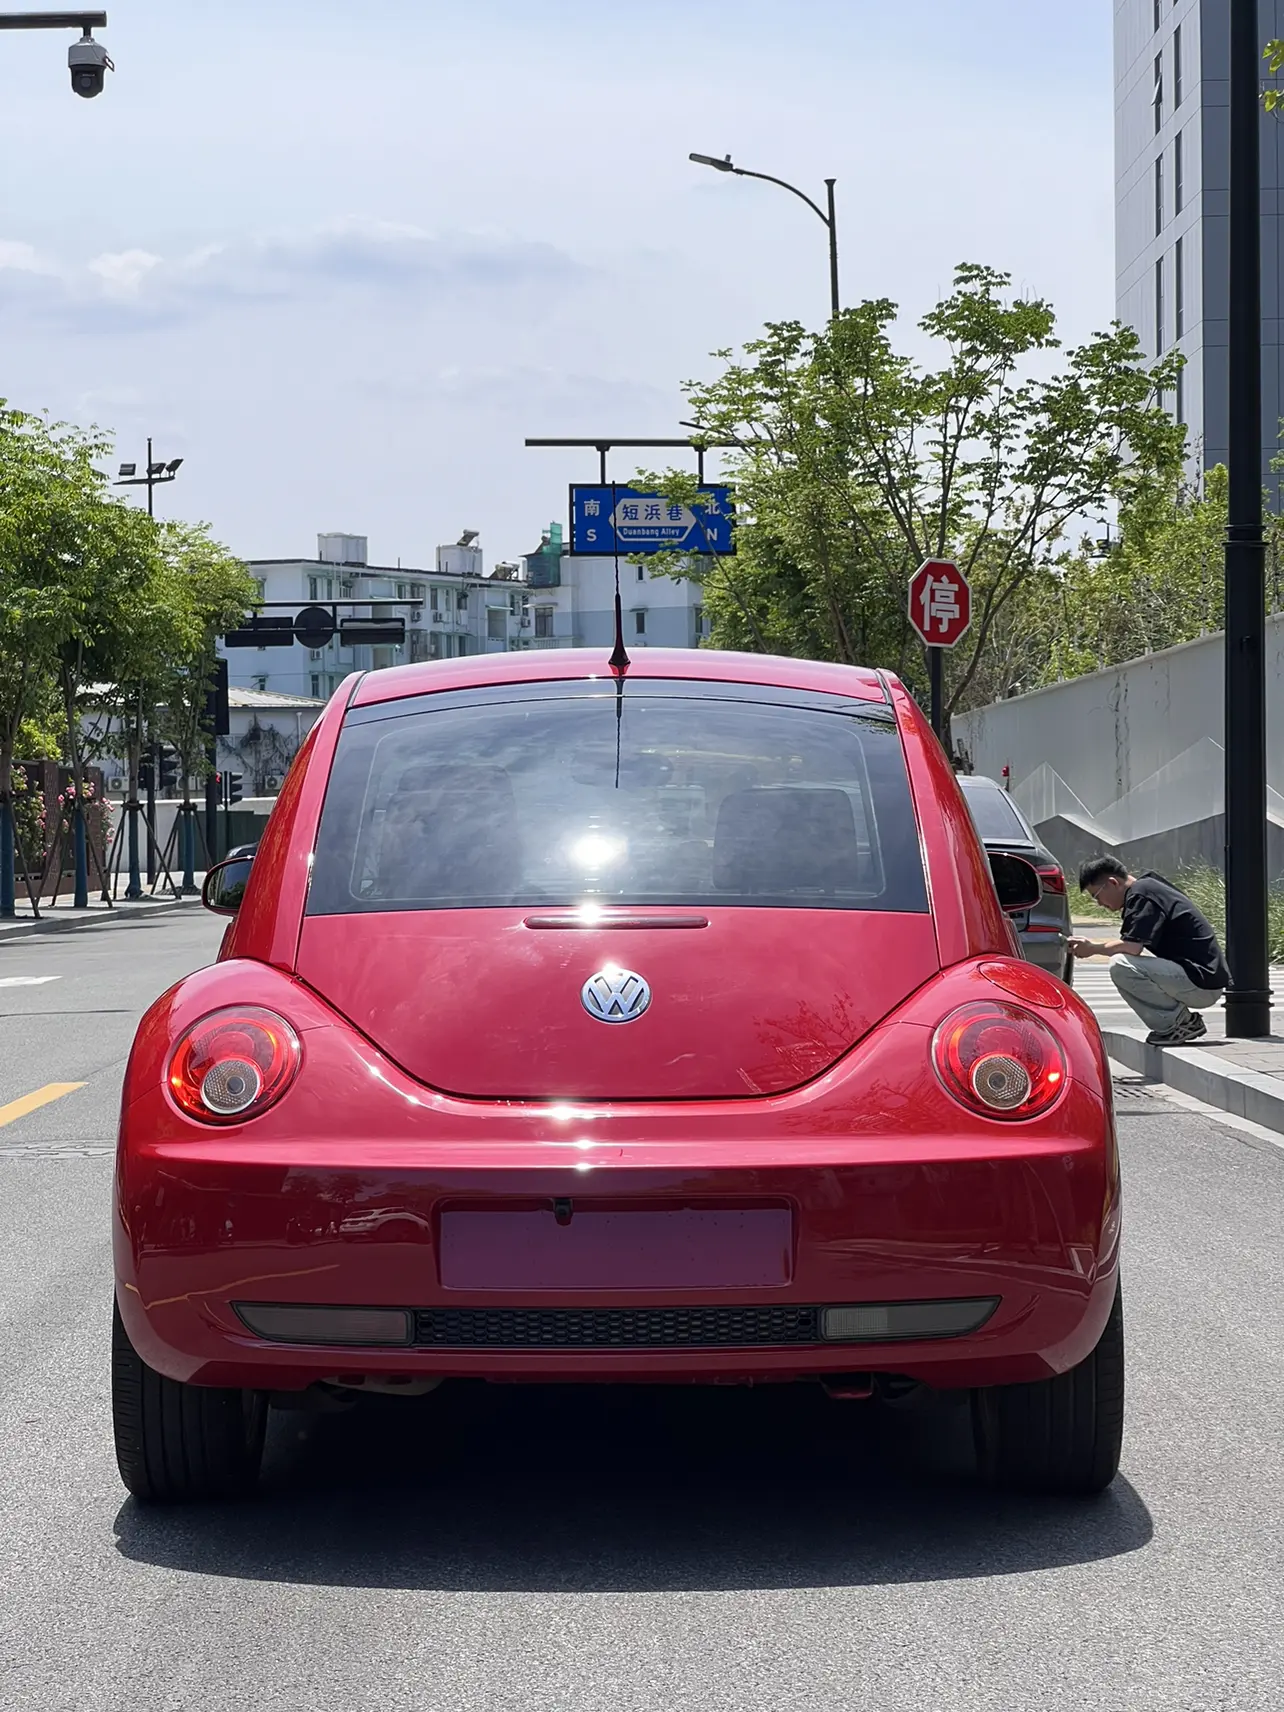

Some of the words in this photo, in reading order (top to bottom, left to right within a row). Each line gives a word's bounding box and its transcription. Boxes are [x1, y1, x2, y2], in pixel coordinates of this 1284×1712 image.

[584, 499, 600, 517] 南
[622, 503, 683, 521] 短浜巷
[704, 501, 720, 515] 北
[586, 528, 597, 542] S
[623, 528, 659, 537] Duanbang
[661, 528, 680, 536] Alley
[706, 528, 718, 541] N
[919, 573, 960, 633] 停
[583, 968, 650, 1022] VW
